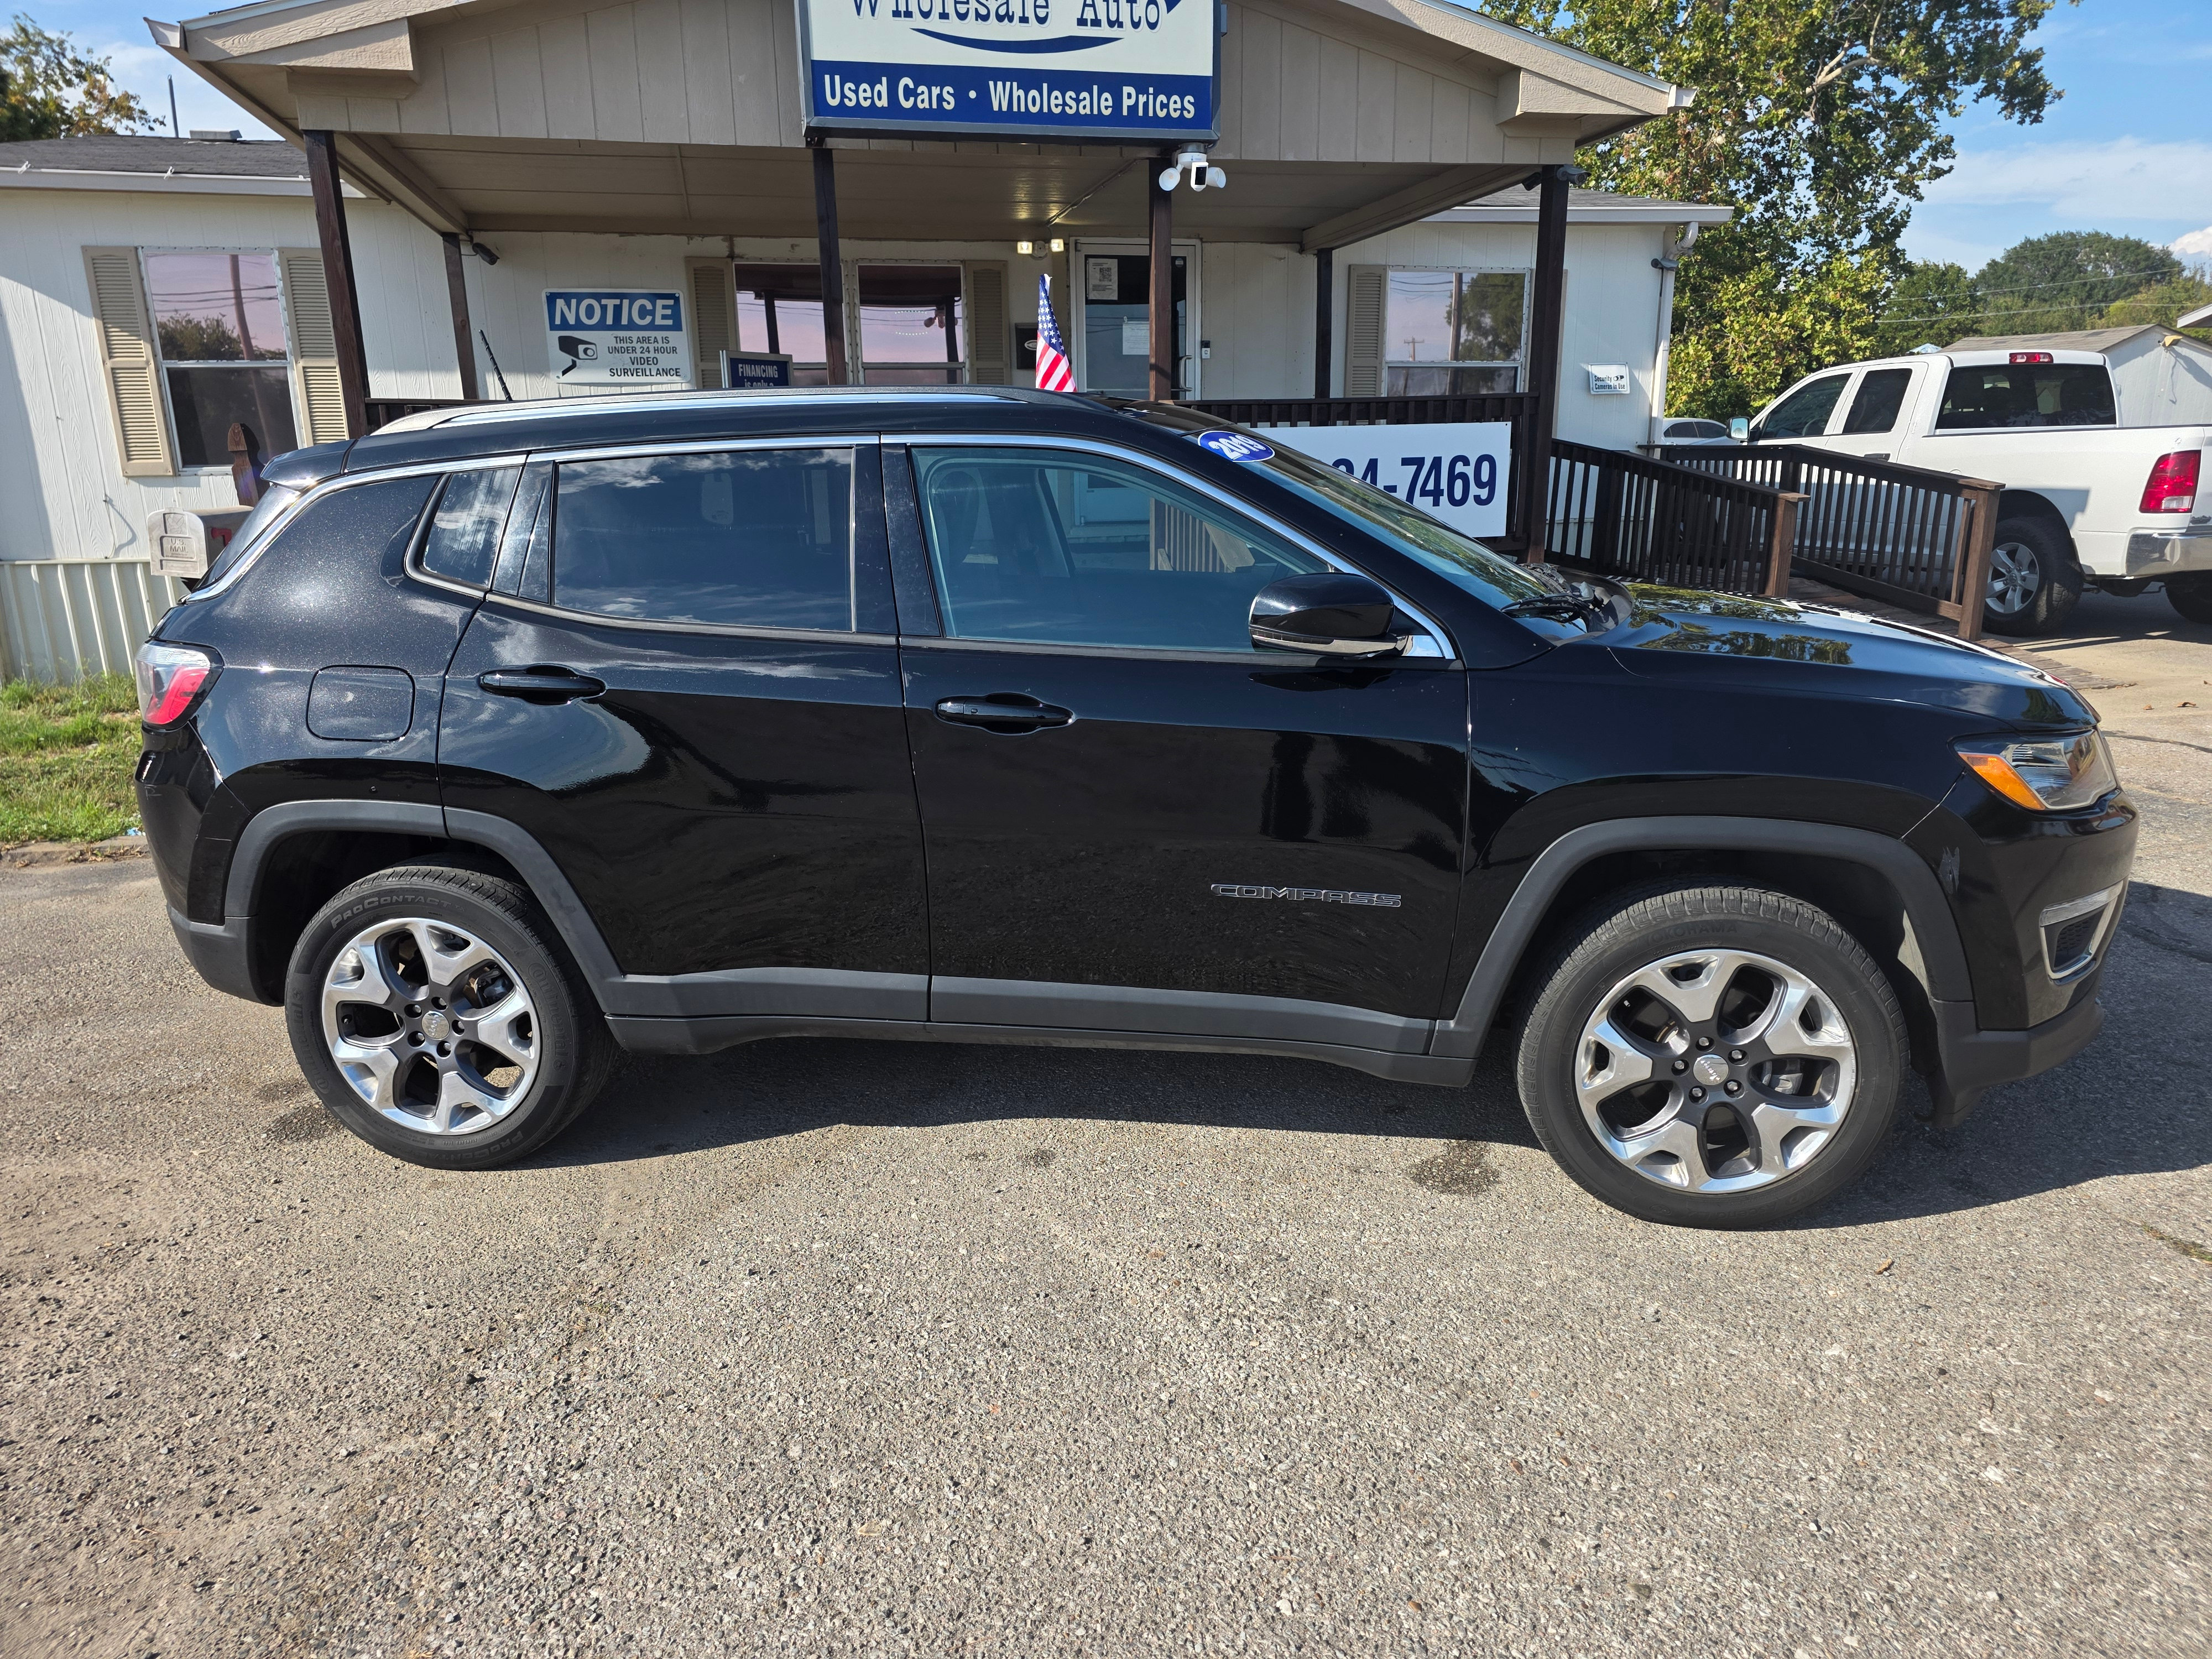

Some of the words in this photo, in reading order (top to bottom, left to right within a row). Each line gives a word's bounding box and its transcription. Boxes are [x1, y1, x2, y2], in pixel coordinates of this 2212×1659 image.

[1076, 0, 1160, 30] Auto
[825, 74, 888, 107] Used
[898, 77, 955, 110] Cars
[989, 81, 1113, 116] Wholesale
[1122, 86, 1195, 119] Prices
[555, 299, 675, 325] NOTICE
[607, 346, 638, 354] UNDER
[639, 346, 651, 354] 24
[653, 346, 678, 354] HOUR
[613, 336, 634, 345] THIS
[636, 336, 659, 345] AREA
[661, 336, 670, 345] IS
[629, 356, 659, 366] VIDEO
[609, 367, 681, 377] SURVEILLANCE
[738, 364, 779, 378] FINANCING
[1208, 435, 1266, 460] 2019
[1211, 884, 1402, 908] COMPASS
